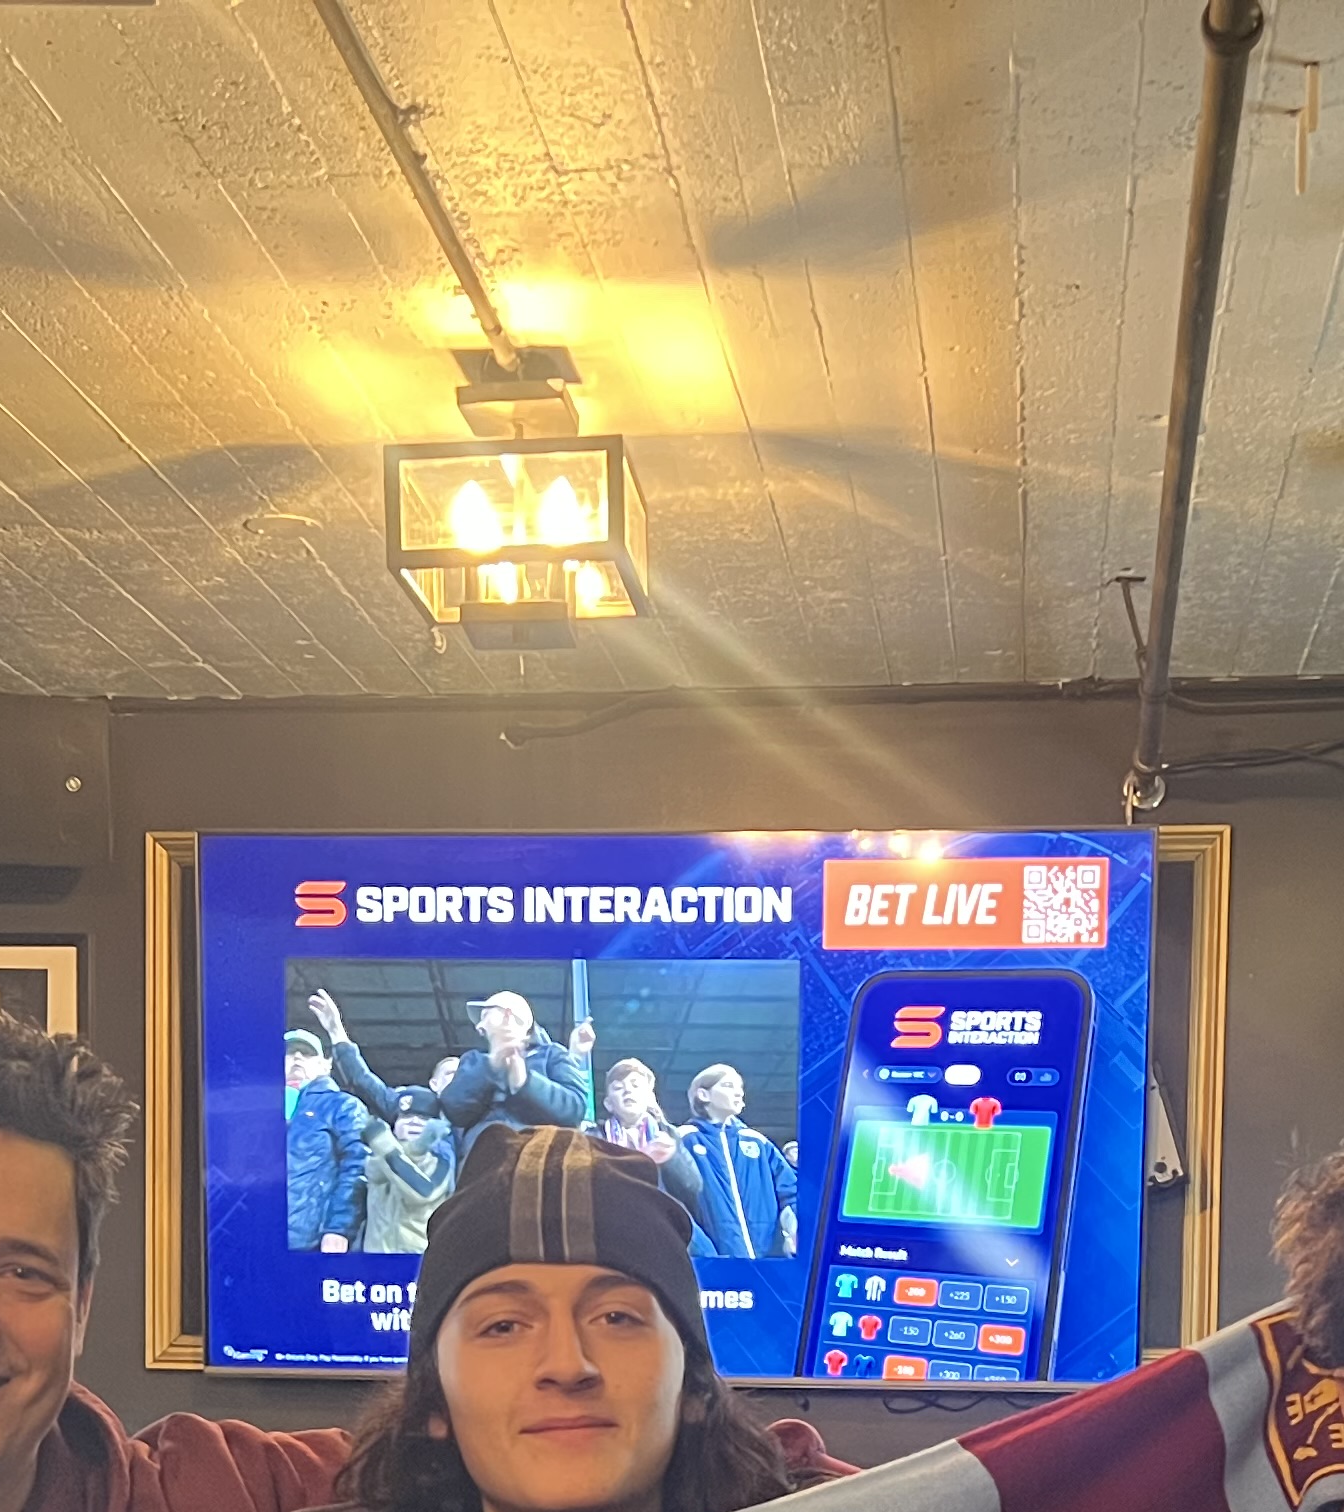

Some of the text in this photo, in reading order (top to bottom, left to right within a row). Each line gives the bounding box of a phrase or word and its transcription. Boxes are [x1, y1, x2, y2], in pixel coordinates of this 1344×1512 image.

[356, 886, 513, 923] SPORTS
[523, 886, 792, 923] INTERACTION
[844, 883, 1003, 926] BET LIVE
[950, 1010, 1043, 1032] SPORTS
[947, 1031, 1040, 1045] INTERACTION
[322, 1279, 366, 1303] Bet
[370, 1284, 402, 1304] on
[700, 1290, 754, 1309] mes
[370, 1307, 413, 1331] wit
